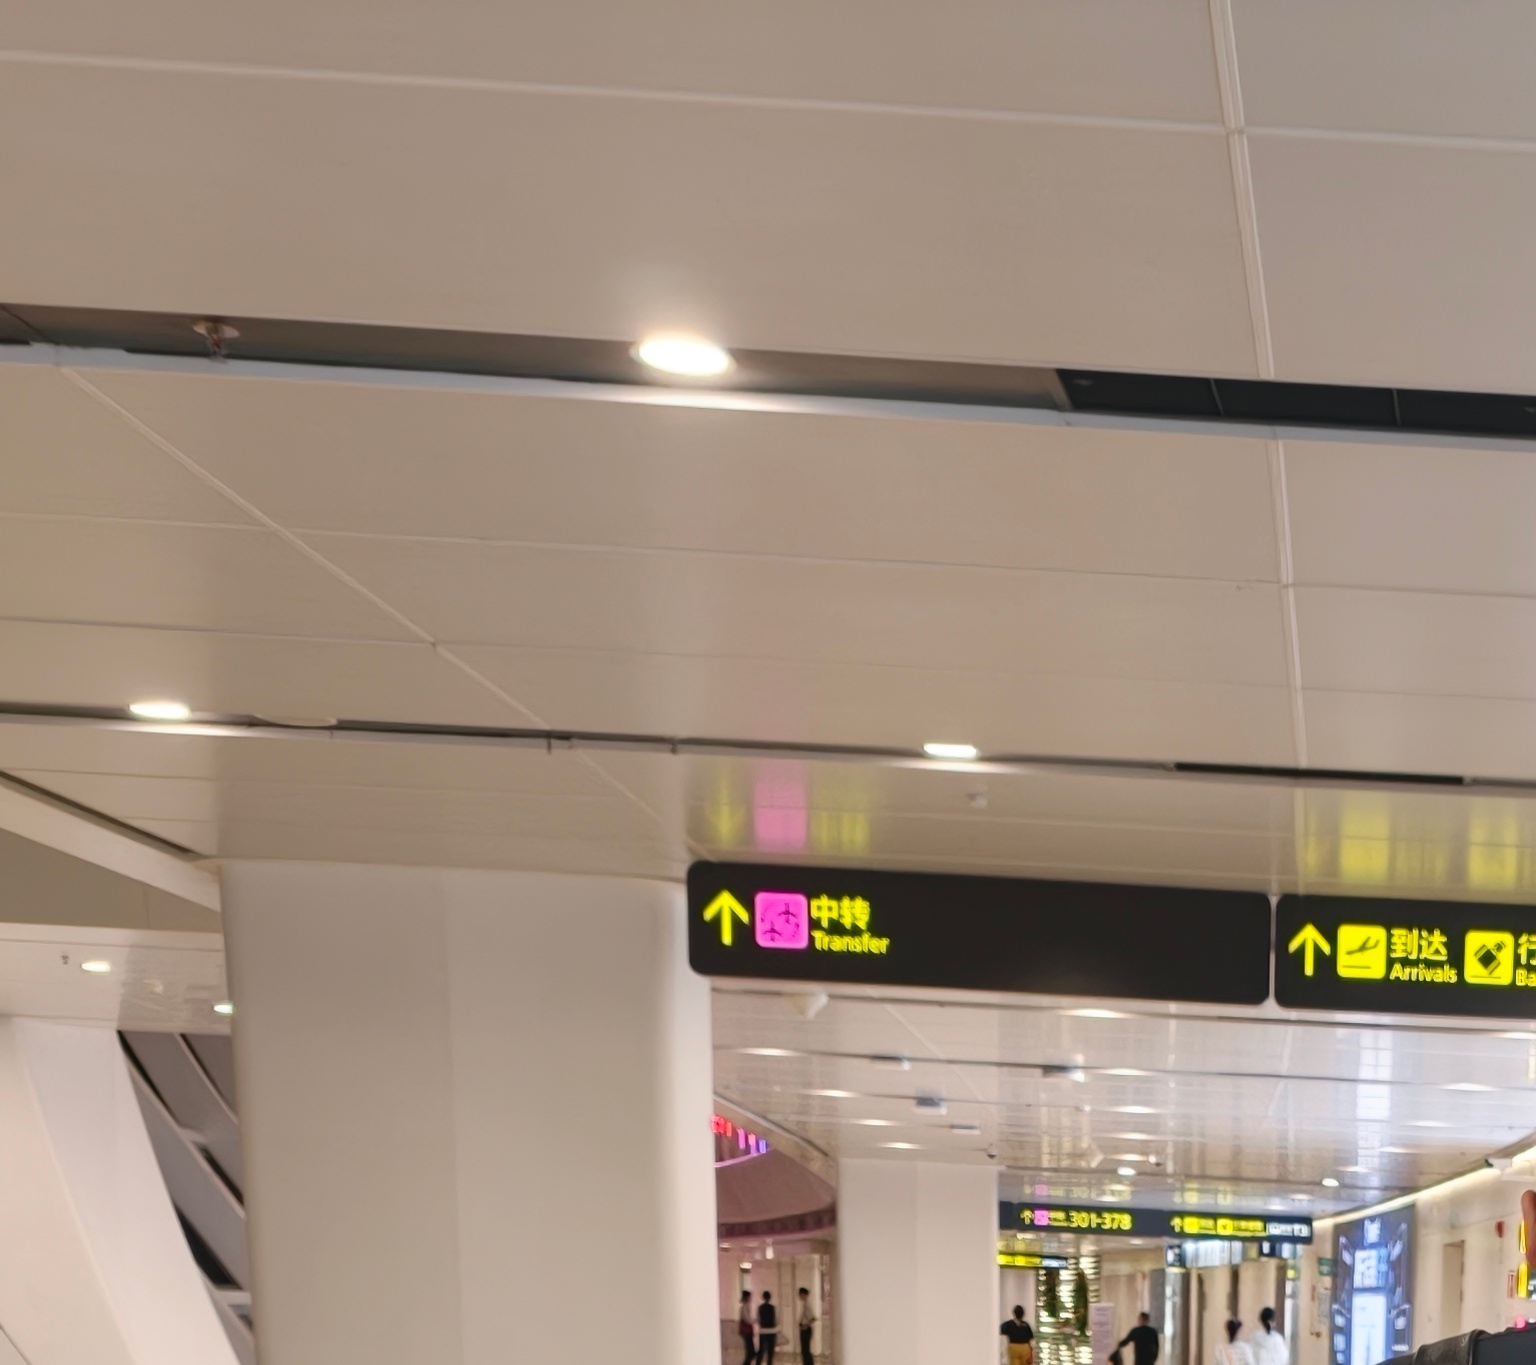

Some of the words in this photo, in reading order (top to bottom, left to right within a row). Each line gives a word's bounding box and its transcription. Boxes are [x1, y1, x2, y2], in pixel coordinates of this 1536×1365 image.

[810, 893, 870, 930] 中转
[810, 930, 890, 954] Transfer
[1390, 927, 1448, 961] 到达
[1389, 961, 1458, 984] Arrivals
